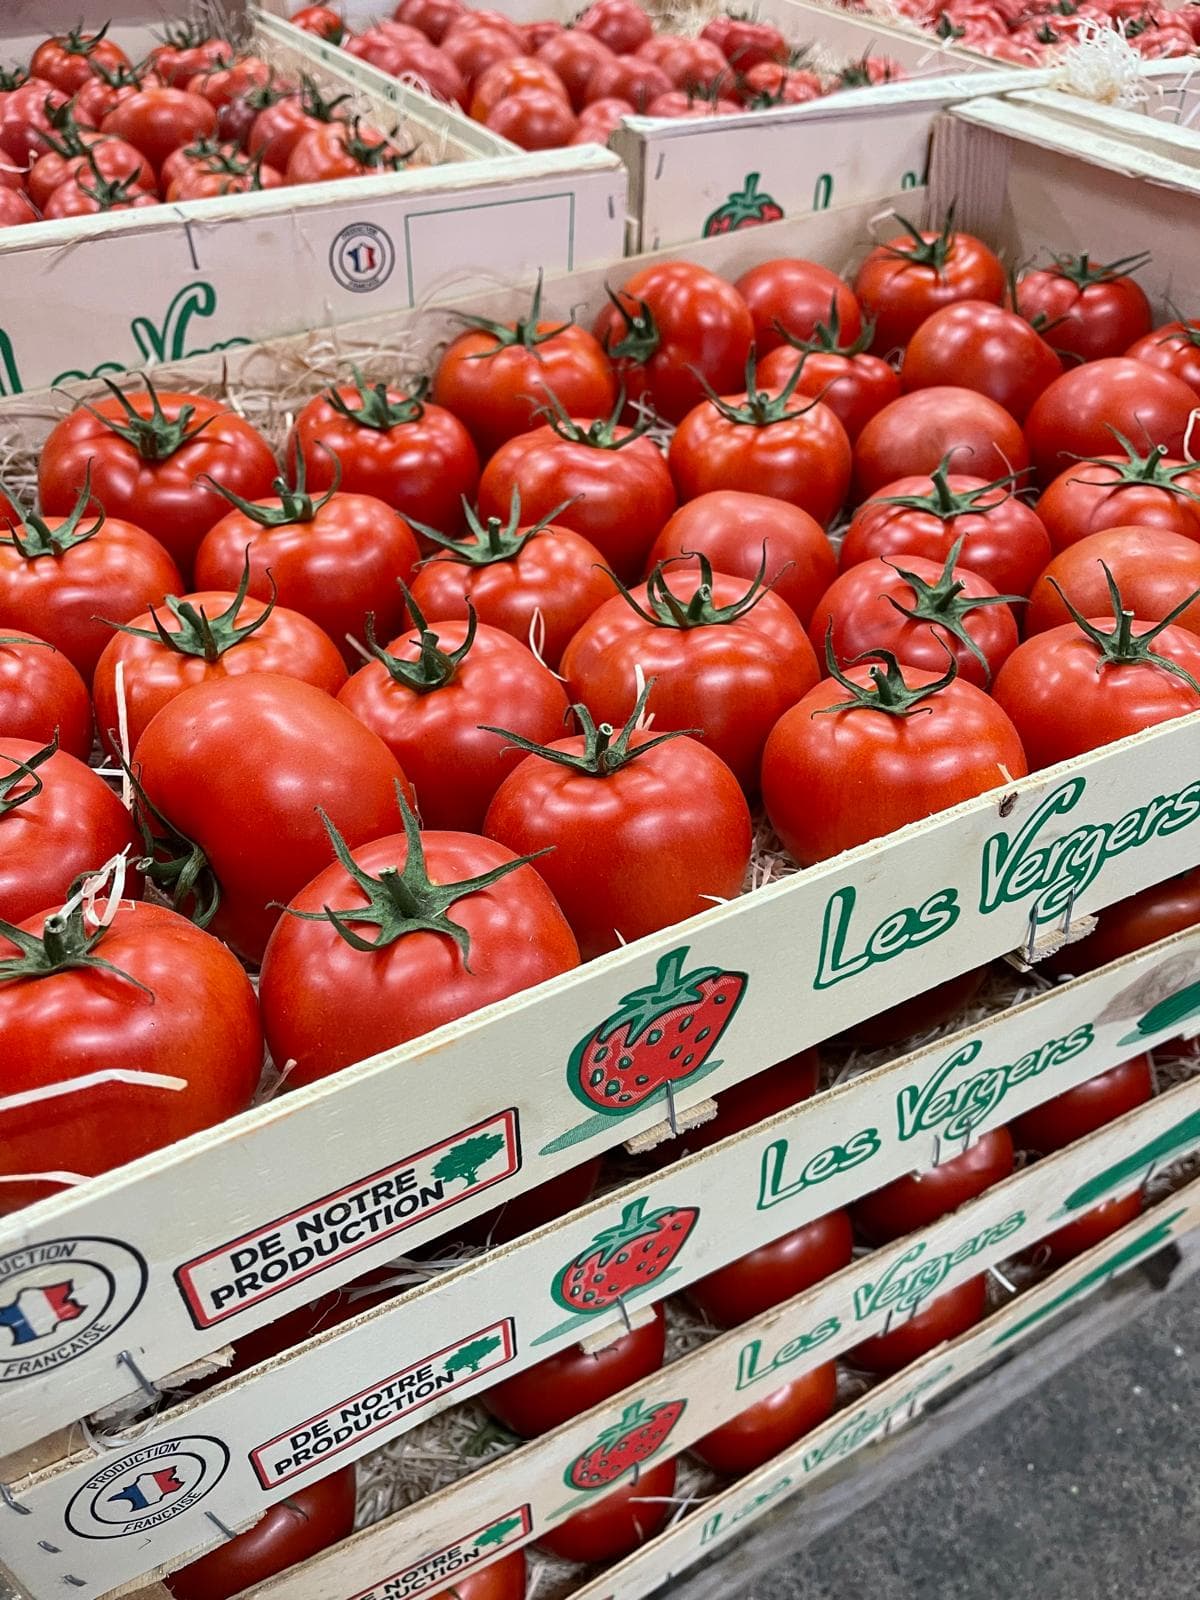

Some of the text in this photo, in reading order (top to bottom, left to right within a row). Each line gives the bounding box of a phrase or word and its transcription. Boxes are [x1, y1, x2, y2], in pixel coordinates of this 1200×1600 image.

[813, 777, 1200, 990] Les Vergers
[756, 1023, 1095, 1210] Les Vergers
[0, 1243, 77, 1276] UCTION
[210, 1180, 445, 1309] PRODUCTION
[230, 1168, 418, 1273] DE NOTRE
[736, 1210, 1026, 1391] Les Vergers
[274, 1370, 455, 1477] PRODUCTION
[289, 1364, 434, 1450] DE NOTRE
[86, 1441, 181, 1490] PRODUCTION
[380, 1547, 480, 1600] UCTION
[384, 1546, 462, 1594] NOTRE
